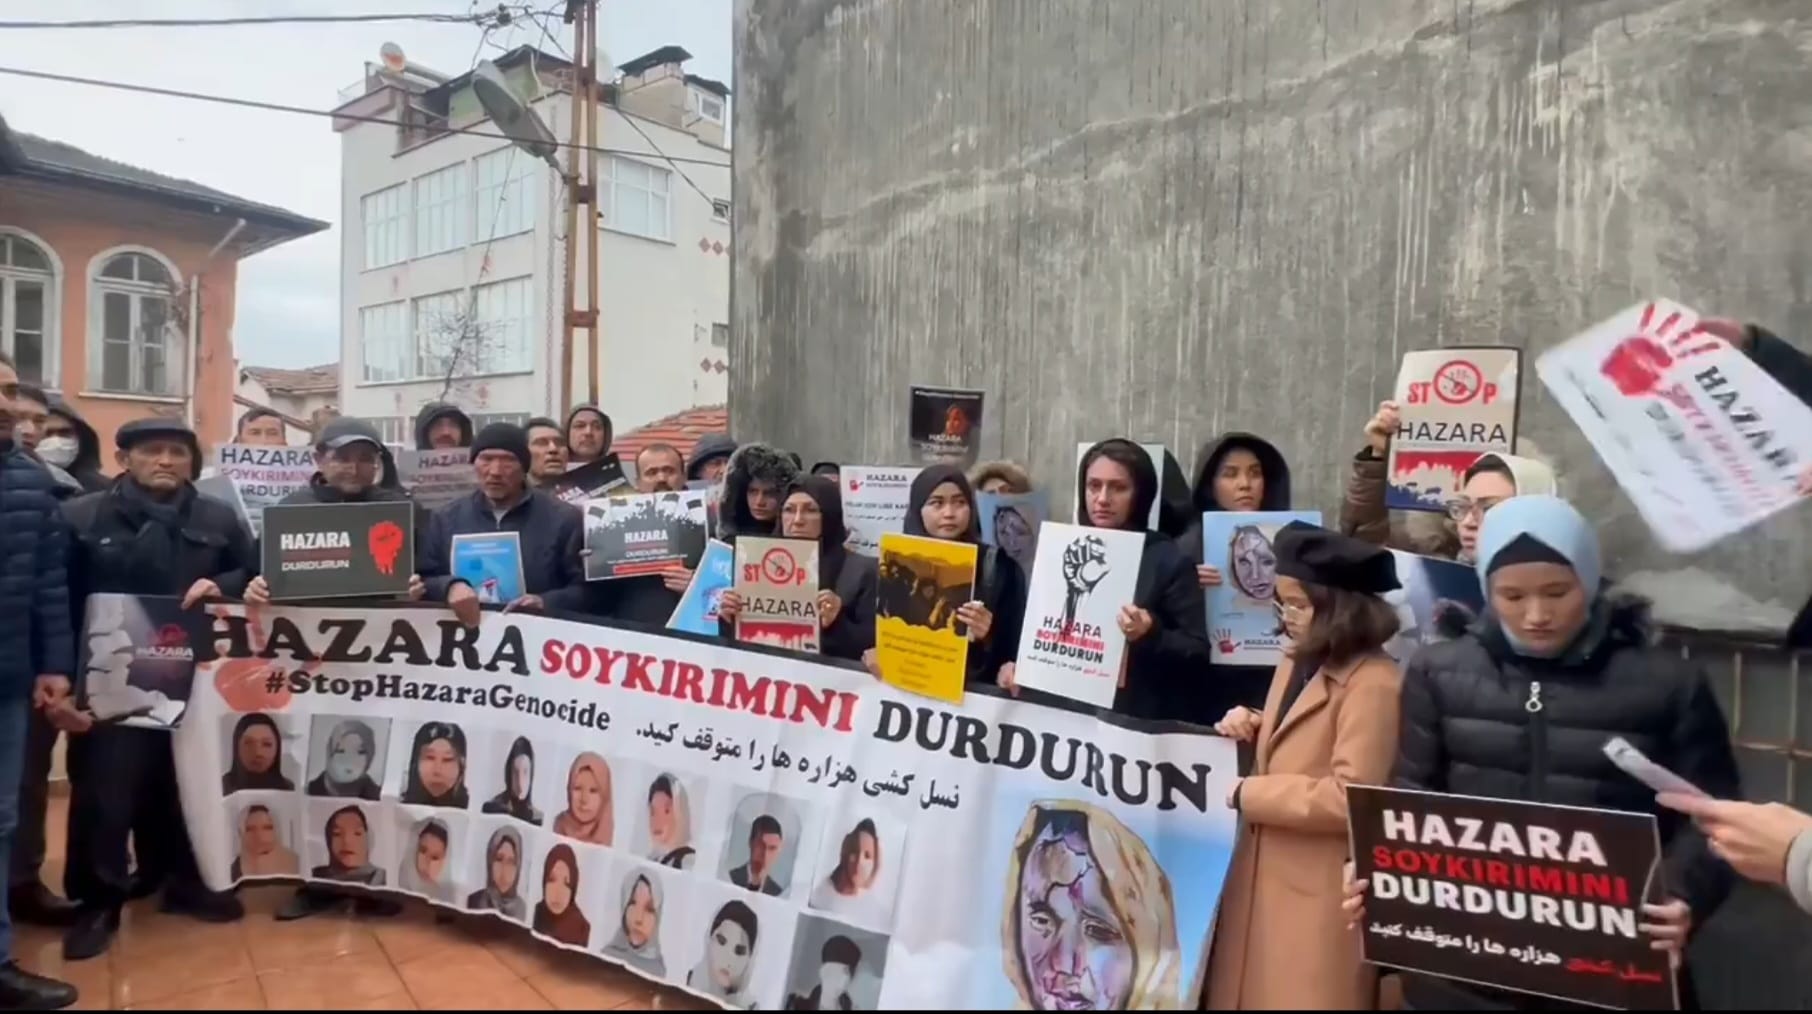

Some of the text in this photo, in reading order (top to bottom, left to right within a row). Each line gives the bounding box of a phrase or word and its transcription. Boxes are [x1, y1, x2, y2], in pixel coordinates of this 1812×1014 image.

[1397, 421, 1507, 443] HAZARA
[221, 447, 314, 467] HAZARA
[281, 531, 351, 550] HAZARA
[624, 530, 668, 543] HAZARA
[741, 596, 817, 618] HAZARA
[1043, 615, 1102, 639] HAZARA
[1033, 639, 1104, 664] DURDURUN
[266, 670, 611, 731] #StopHazaraGenocide
[200, 616, 1211, 812] HAZARA SOYKIRIMINI DURDURUN
[682, 726, 741, 761] متوقف
[749, 739, 765, 771] را
[771, 744, 791, 770] ها
[798, 755, 857, 786] هزاره
[863, 769, 915, 797] کشی
[920, 779, 960, 810] نسل
[1382, 809, 1607, 866] HAZARA
[1372, 845, 1630, 903] SOYKIRIMINI
[1371, 871, 1638, 939] DURDURUN
[1405, 924, 1463, 948] متوقف
[1466, 935, 1480, 954] را
[1483, 938, 1505, 956] ها
[1509, 944, 1561, 966] هزاره
